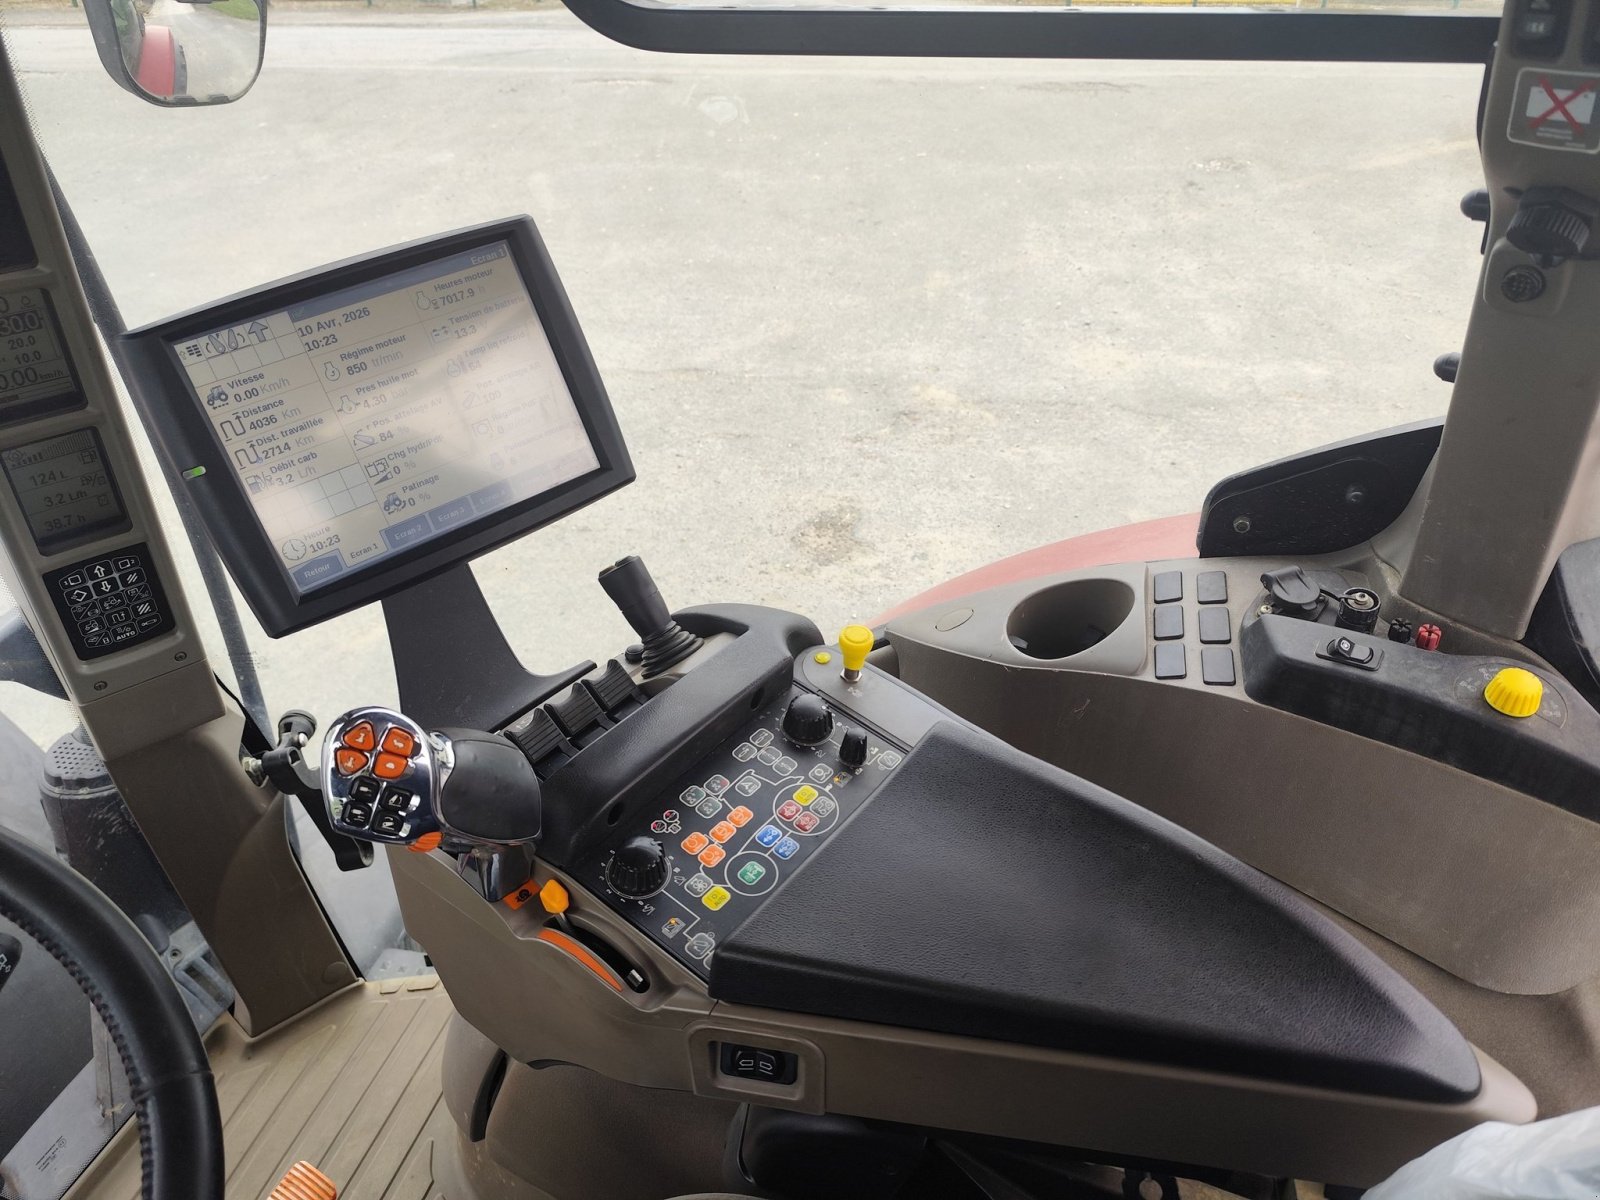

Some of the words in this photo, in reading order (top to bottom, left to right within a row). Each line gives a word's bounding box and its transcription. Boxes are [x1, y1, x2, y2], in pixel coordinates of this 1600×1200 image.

[434, 278, 463, 292] Heures
[464, 268, 493, 282] moteur
[440, 288, 475, 306] 7017.9
[298, 324, 313, 338] 10
[342, 307, 371, 323] 2026
[448, 309, 482, 325] Tension
[8, 335, 36, 350] 20.0
[304, 334, 338, 352] 10:23
[340, 346, 374, 362] Régime
[375, 334, 407, 350] moteur
[15, 350, 42, 365] 10.0
[346, 361, 368, 376] 850
[226, 372, 265, 389] Vitesse
[355, 383, 376, 396] Pres
[377, 375, 400, 389] huile
[234, 387, 259, 403] 0.00
[260, 377, 291, 394] Km/h
[241, 399, 284, 418] Distance
[363, 393, 387, 409] 4.30
[248, 414, 278, 431] 4036
[281, 406, 302, 420] Km
[255, 433, 280, 447] Dist.
[280, 417, 324, 438] travaillée
[379, 430, 394, 442] 84
[262, 442, 292, 460] 2714
[295, 435, 314, 448] Km
[387, 450, 406, 461] Chg
[270, 460, 296, 475] Débit
[297, 451, 318, 464] carb
[402, 474, 440, 493] Patinage
[44, 493, 66, 508] 3.2
[44, 514, 72, 532] 38.7
[309, 534, 341, 554] 10:23
[116, 631, 136, 641] AUTO
